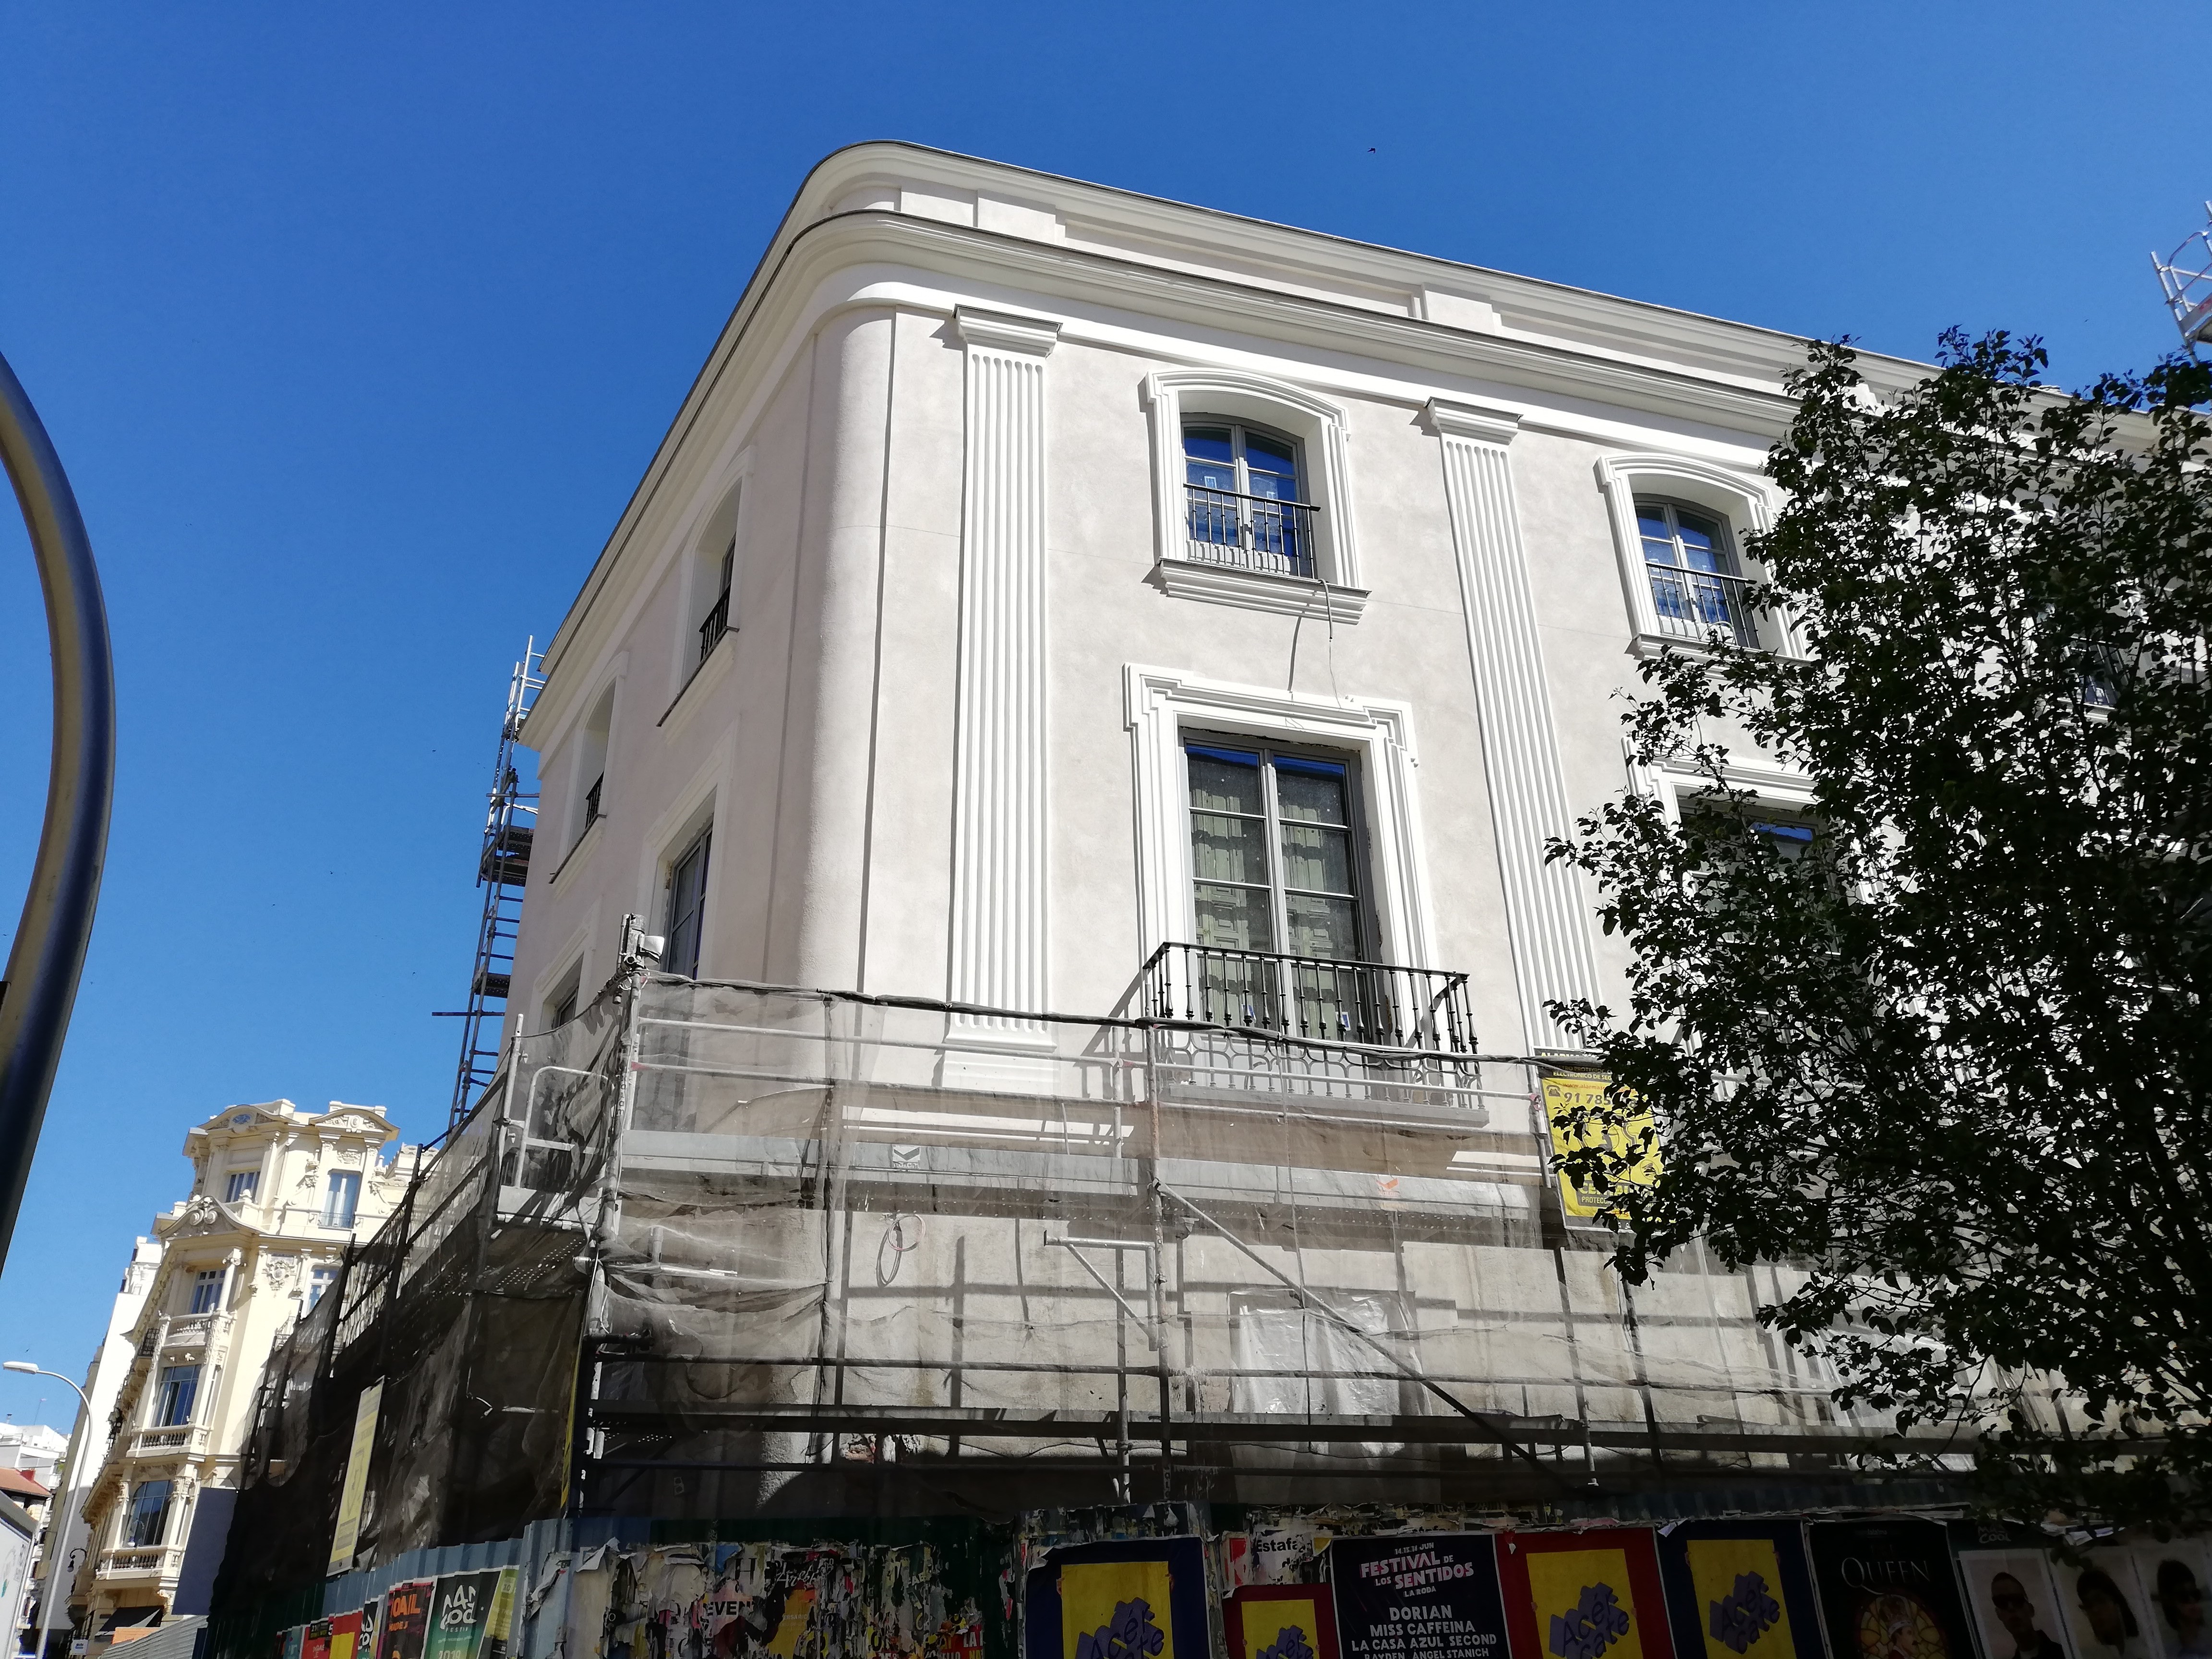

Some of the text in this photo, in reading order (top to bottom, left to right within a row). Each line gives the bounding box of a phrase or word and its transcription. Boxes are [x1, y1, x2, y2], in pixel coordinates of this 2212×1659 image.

[1564, 1092, 1580, 1103] 91
[1419, 1542, 1434, 1551] JUN
[1359, 1551, 1454, 1578] FESTIVAL DE
[1375, 1562, 1475, 1590] LOS SENTIDOS
[1841, 1557, 1931, 1595] QUEEN
[1417, 1586, 1437, 1596] RODA
[1389, 1605, 1453, 1621] DORIAN
[1370, 1620, 1476, 1637] MISS CAFFEINA
[1351, 1634, 1497, 1651] LA CASA AZUL SECOND
[1446, 1647, 1490, 1659] STANICH
